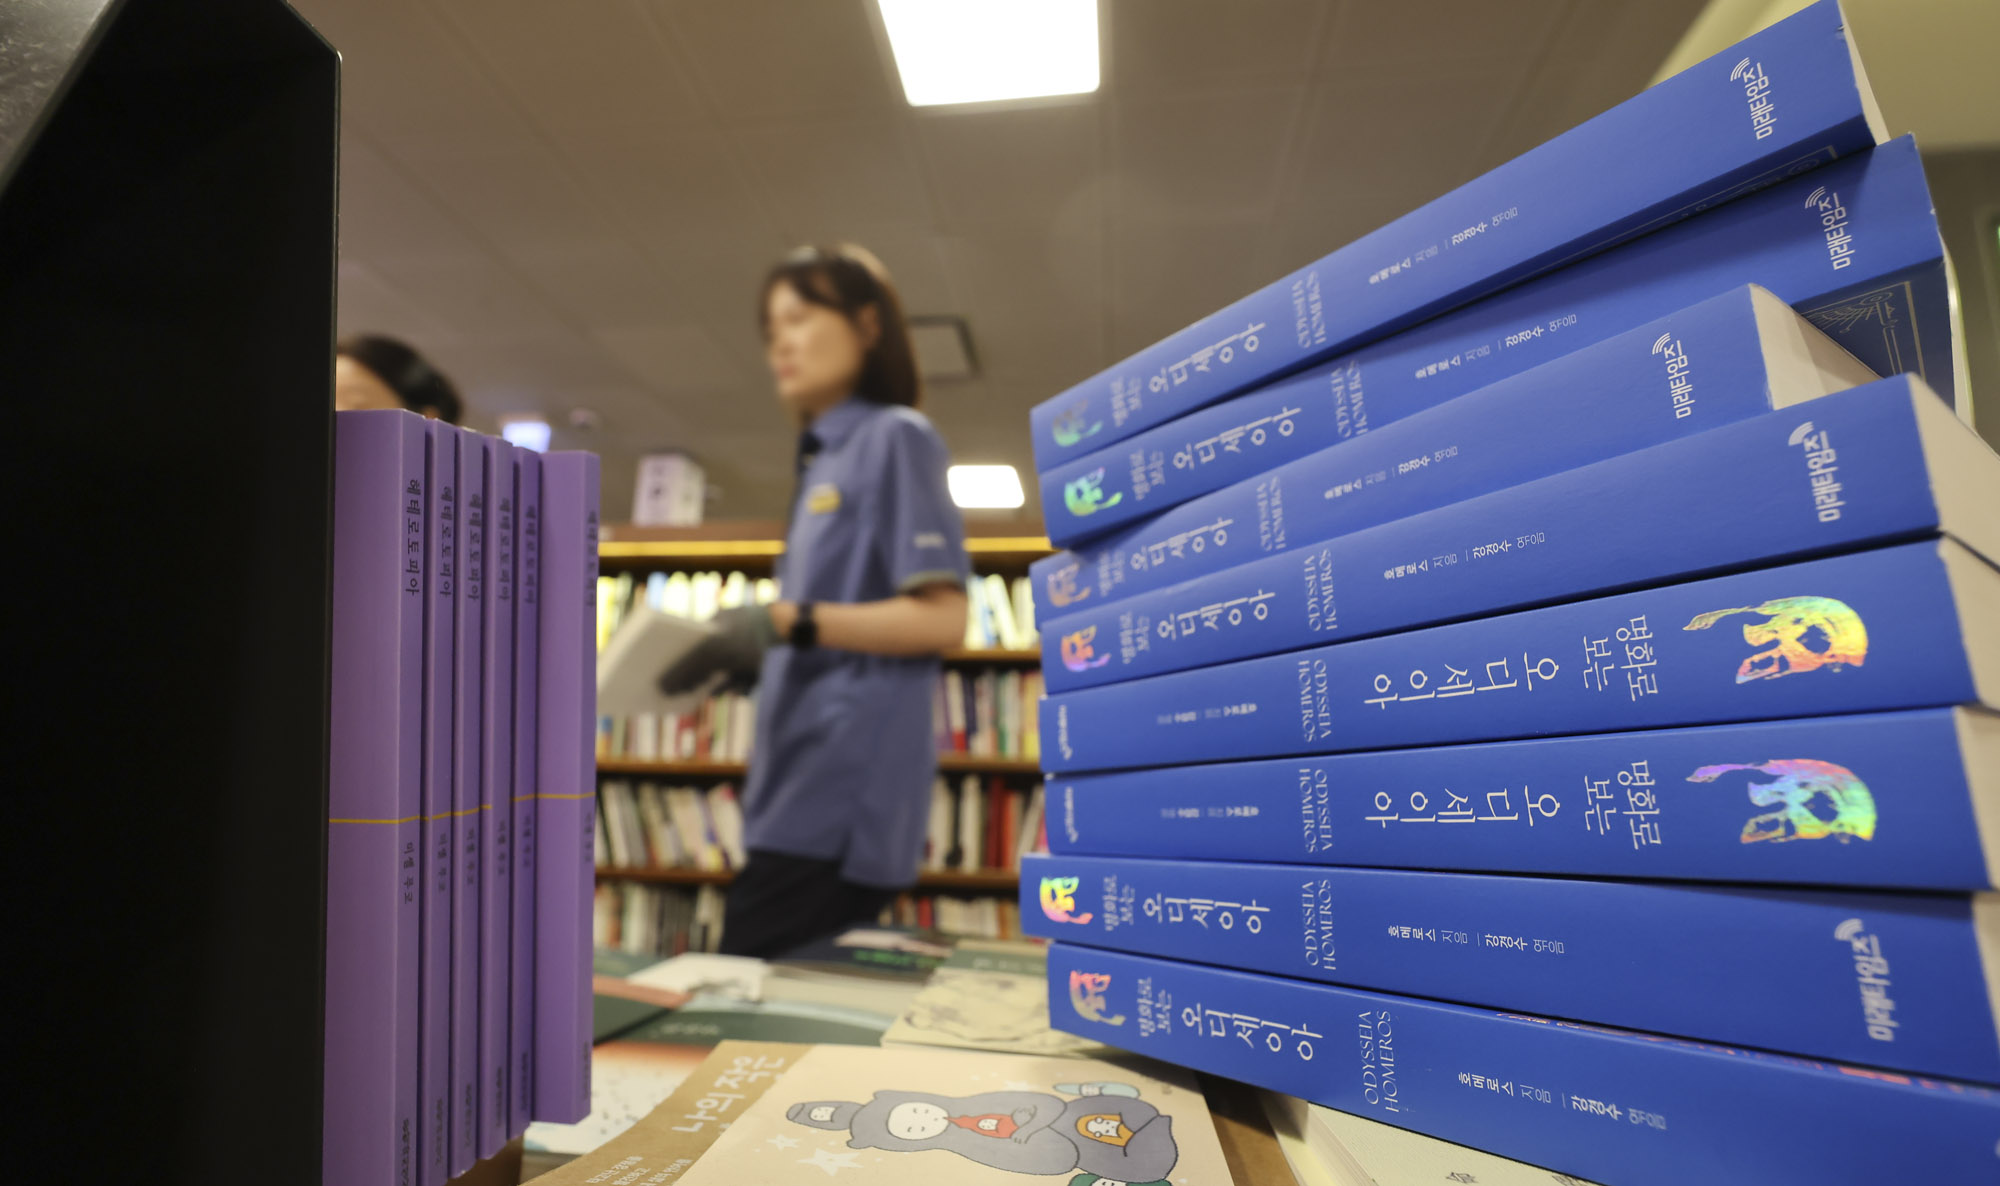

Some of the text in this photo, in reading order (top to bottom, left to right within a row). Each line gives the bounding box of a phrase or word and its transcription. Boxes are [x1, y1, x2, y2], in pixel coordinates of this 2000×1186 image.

[1743, 62, 1777, 140] 미래타임즈
[1452, 221, 1488, 246] 강경수
[1819, 193, 1856, 270] 미래타임즈
[1149, 322, 1265, 393] 오디세이아
[1505, 326, 1544, 348] 강경수
[1664, 340, 1695, 419] 미래타임즈
[1173, 407, 1301, 469] 오디세이아
[1398, 455, 1430, 475] 강경수
[1803, 430, 1847, 523] 미래타임즈
[406, 478, 421, 597] 헤테로토피아
[439, 485, 454, 598] 헤테로토피아
[467, 493, 482, 601] 헤테로토피아
[1130, 517, 1233, 571] 오디세이아
[1472, 539, 1512, 559] 강경수
[1516, 532, 1545, 549] 엮음
[1157, 589, 1275, 640] 오디세이아
[1364, 652, 1559, 710] 오디세이아
[1583, 636, 1614, 691] 보는
[1615, 615, 1658, 701] 명화로
[1298, 659, 1317, 743] HOMEROS
[1313, 659, 1332, 739] ODYSSEIA
[1299, 768, 1318, 853] HOMEROS
[1314, 769, 1333, 851] ODYSSEIA
[1365, 785, 1560, 829] 오디세이아
[1584, 775, 1616, 835] 보는
[1617, 760, 1661, 849] 명화로
[403, 878, 414, 905] 푸코
[1143, 893, 1271, 934] 오디세이아
[1301, 880, 1320, 967] ODYSSEIA
[1318, 879, 1337, 971] HOMEROS
[1388, 925, 1565, 955] 호메로스 지음 강경수 엮음
[1851, 934, 1900, 1042] 미래타임즈
[1181, 1002, 1323, 1061] 오디세이아
[1358, 1010, 1379, 1105] ODYSSEIA
[1377, 1010, 1400, 1113] HOMEROS
[672, 1092, 746, 1132] 나의
[713, 1056, 784, 1088] 작은
[1458, 1071, 1514, 1096] 호메로스
[1520, 1084, 1552, 1103] 지음
[1570, 1095, 1623, 1121] 강경수
